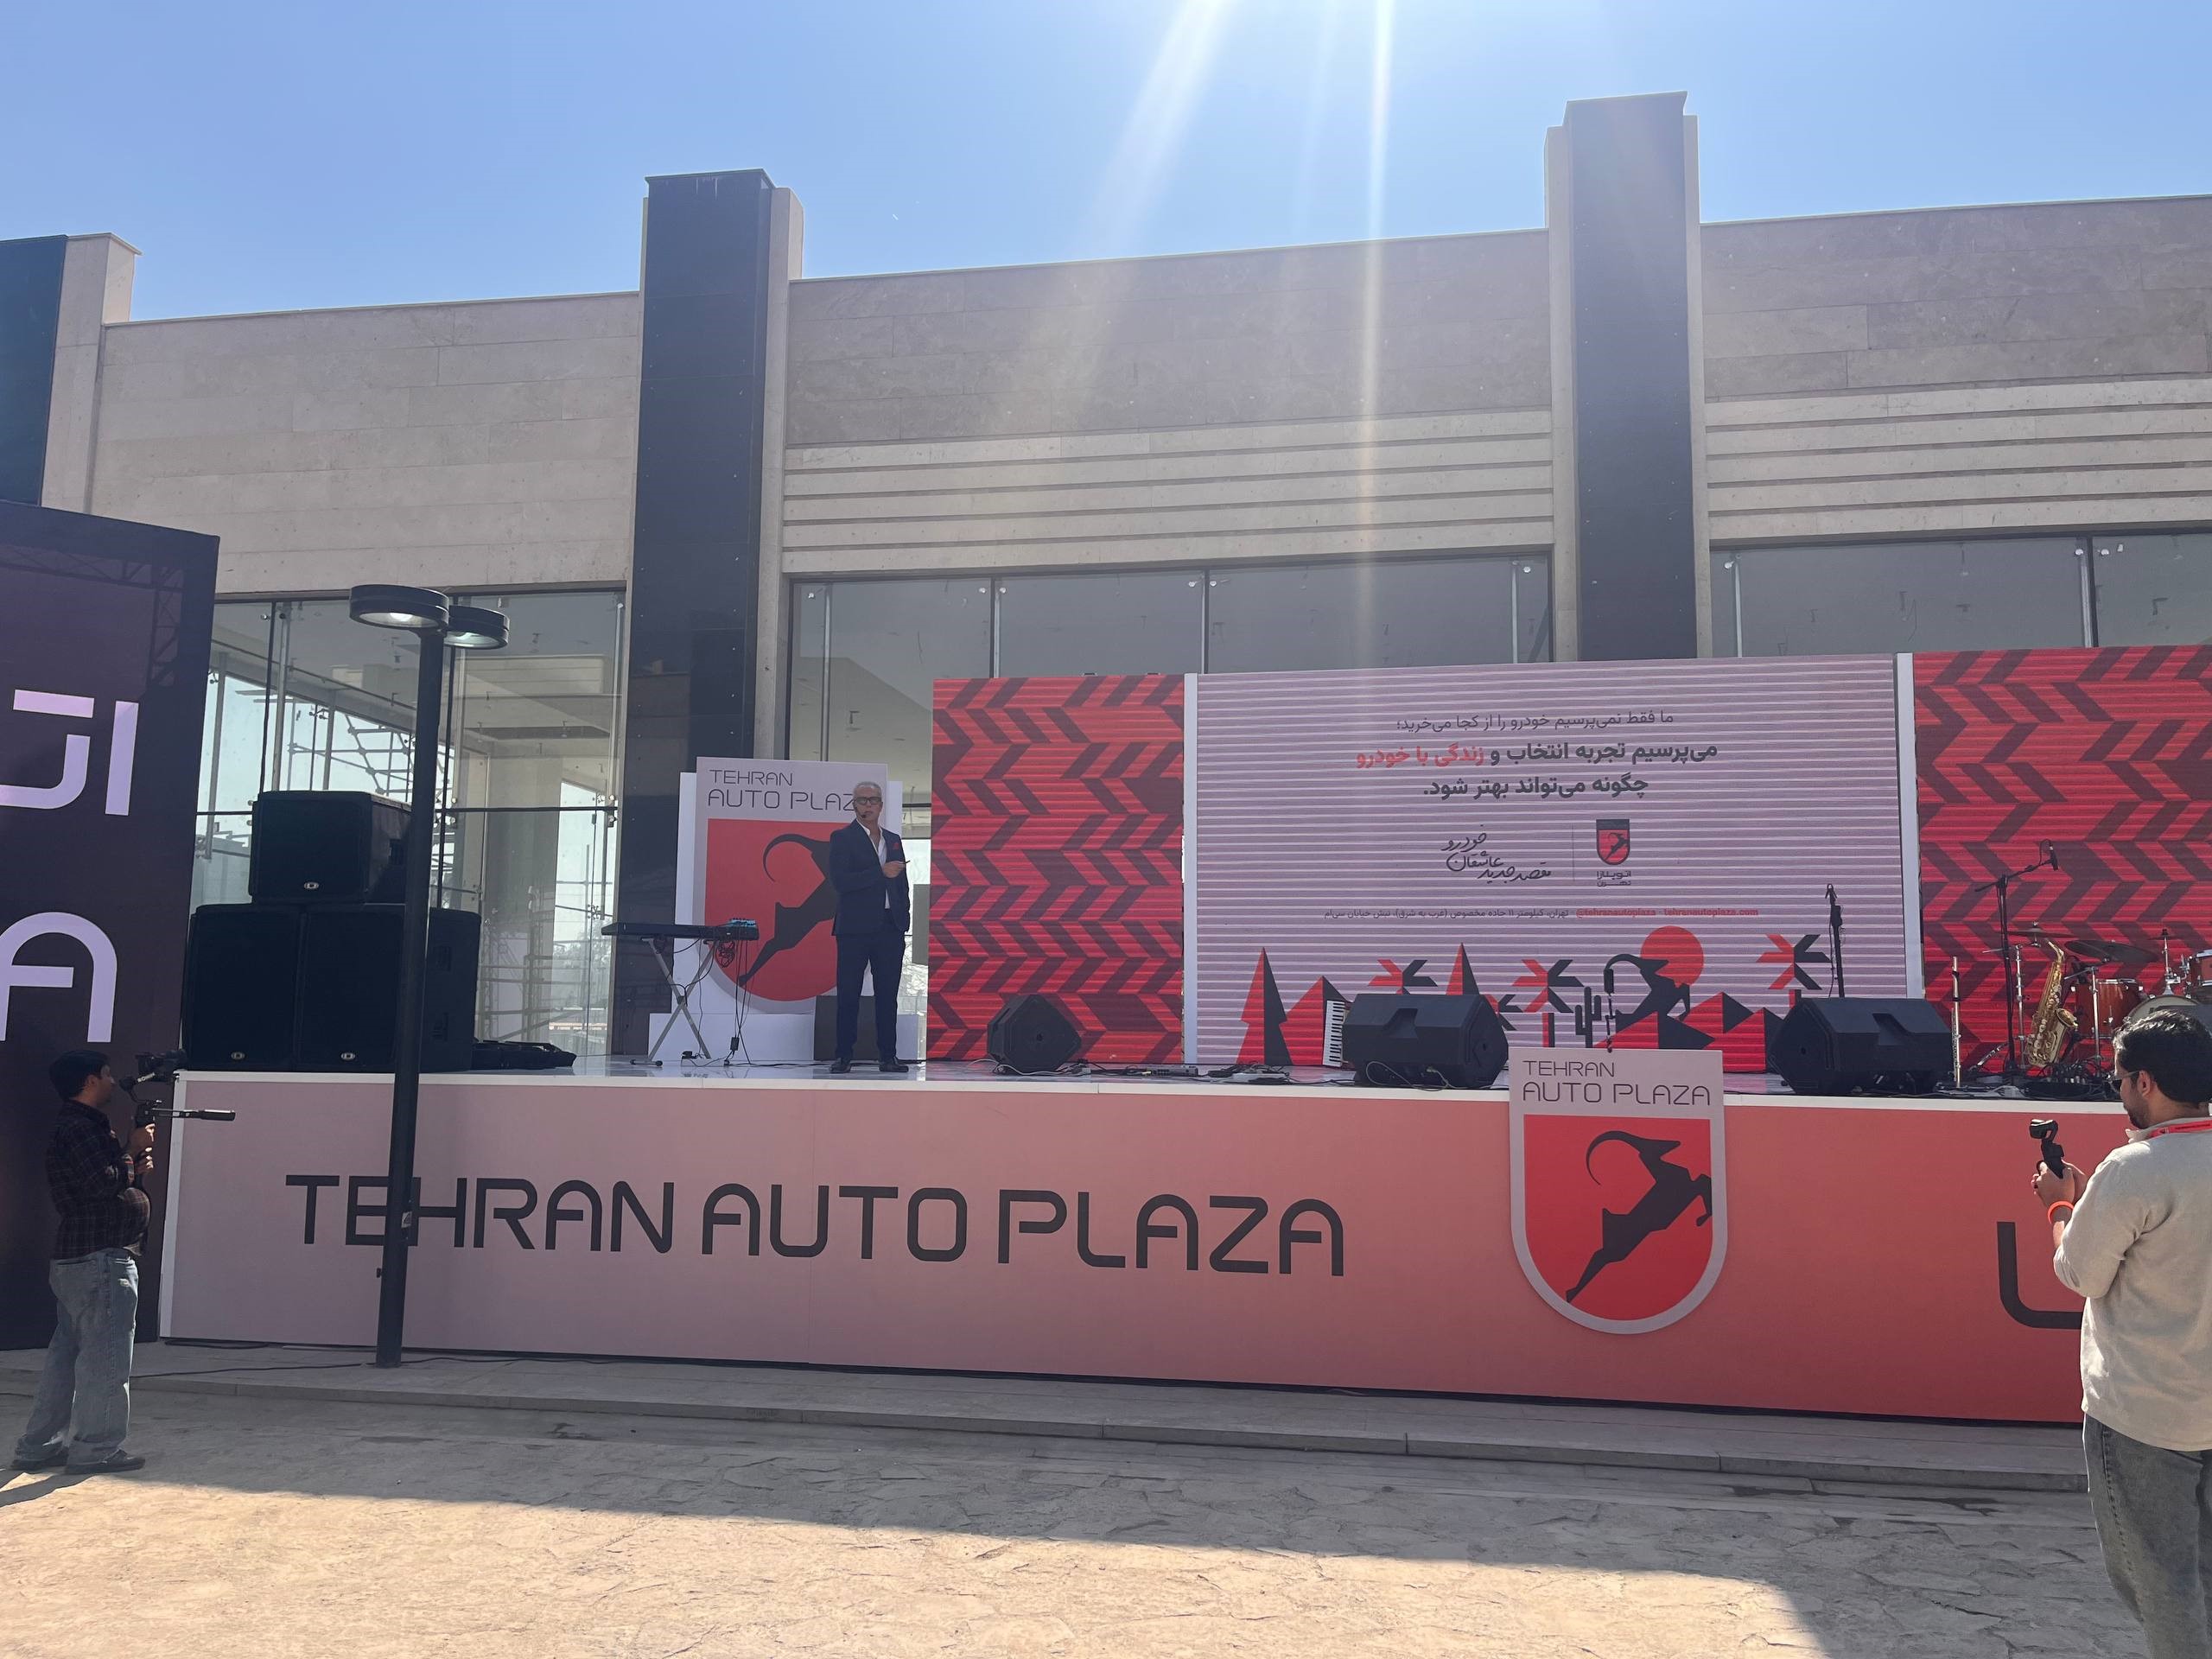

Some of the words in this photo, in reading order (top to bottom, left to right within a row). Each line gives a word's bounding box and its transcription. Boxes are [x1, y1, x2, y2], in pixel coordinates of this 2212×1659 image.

[1456, 715, 1479, 730] کجا
[1484, 714, 1492, 731] از
[1497, 714, 1506, 730] را
[1511, 714, 1549, 730] خودرو
[1626, 709, 1656, 724] فقط
[1661, 709, 1674, 723] ما
[1356, 746, 1411, 769] خودرو
[1416, 746, 1429, 766] با
[1433, 741, 1484, 767] زندگی
[1490, 749, 1500, 766] و
[1506, 742, 1568, 765] انتخاب
[1575, 742, 1625, 764] تجربه
[709, 769, 793, 786] TEHRAN
[1592, 772, 1649, 798] چگونه
[708, 788, 780, 809] AUTO
[790, 791, 854, 811] PLAZ
[1423, 778, 1468, 800] شود.
[1473, 779, 1509, 800] بهتر
[1441, 823, 1487, 852] خودرو
[1522, 1060, 1615, 1077] TEHRAN
[1522, 1081, 1602, 1103] AUTO
[1612, 1084, 1711, 1106] PLAZA
[285, 1174, 675, 1254] TEHRAN
[701, 1183, 968, 1262] AUTO
[997, 1189, 1344, 1277] PLAZA
